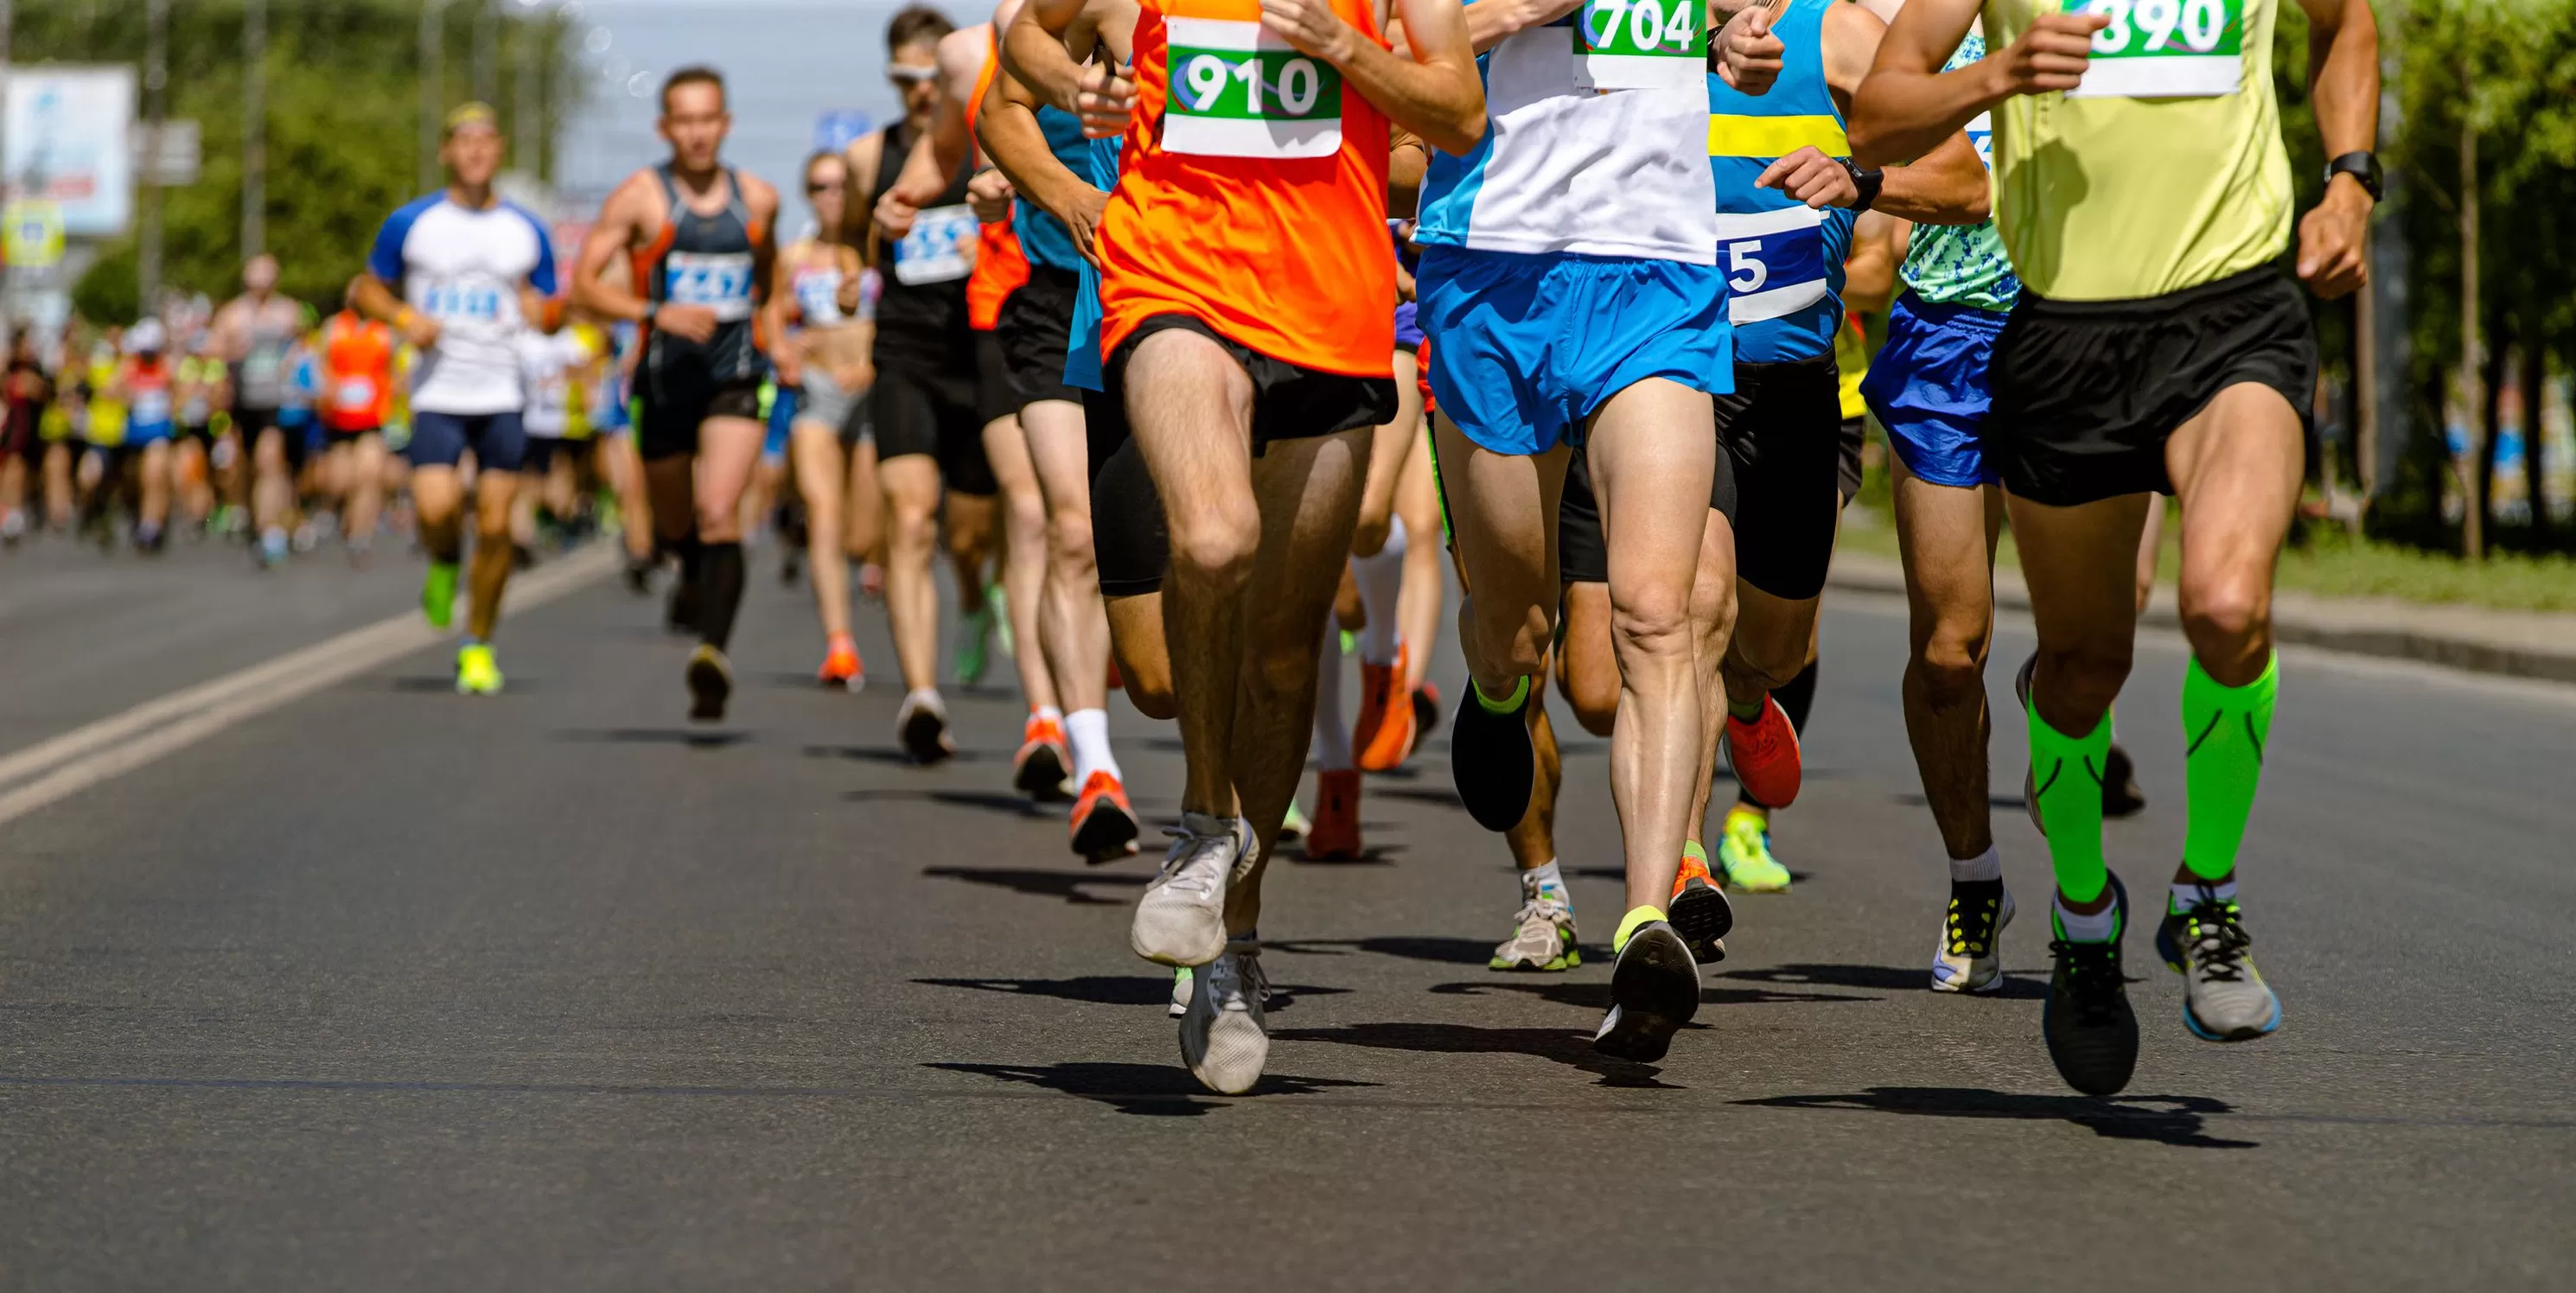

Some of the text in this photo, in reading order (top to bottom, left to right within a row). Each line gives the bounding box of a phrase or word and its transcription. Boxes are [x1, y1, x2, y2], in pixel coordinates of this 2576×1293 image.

[1594, 0, 1694, 51] 704
[1187, 54, 1319, 116] 910
[1729, 239, 1767, 293] 5
